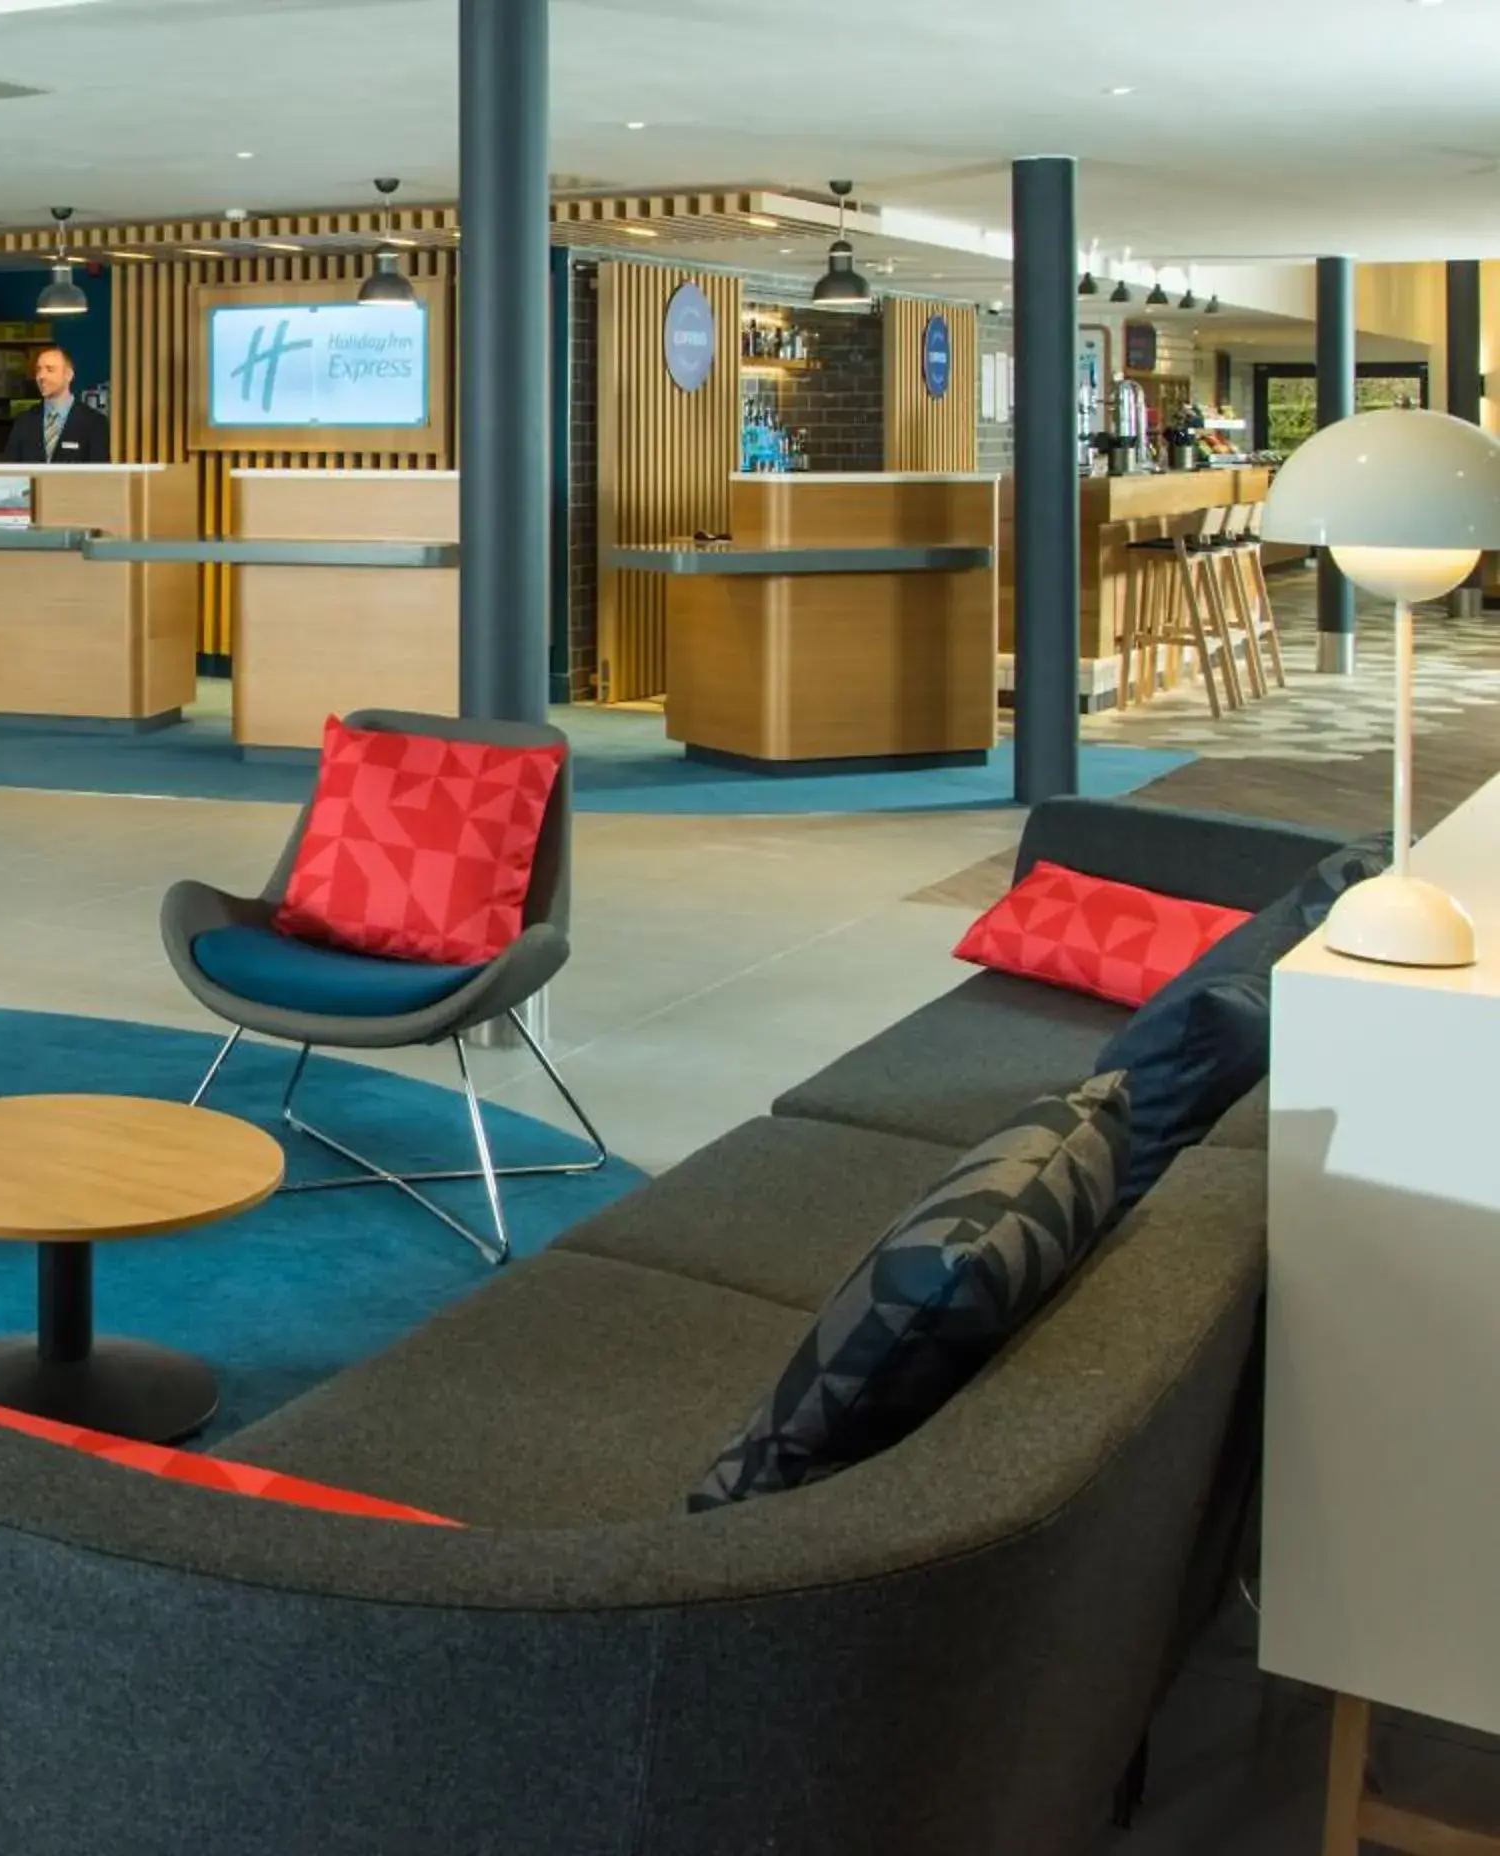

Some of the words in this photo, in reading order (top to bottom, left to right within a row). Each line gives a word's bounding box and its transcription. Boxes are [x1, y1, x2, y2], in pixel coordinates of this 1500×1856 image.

[328, 332, 387, 352] Holiday
[388, 330, 412, 349] Inn
[328, 353, 412, 383] Express
